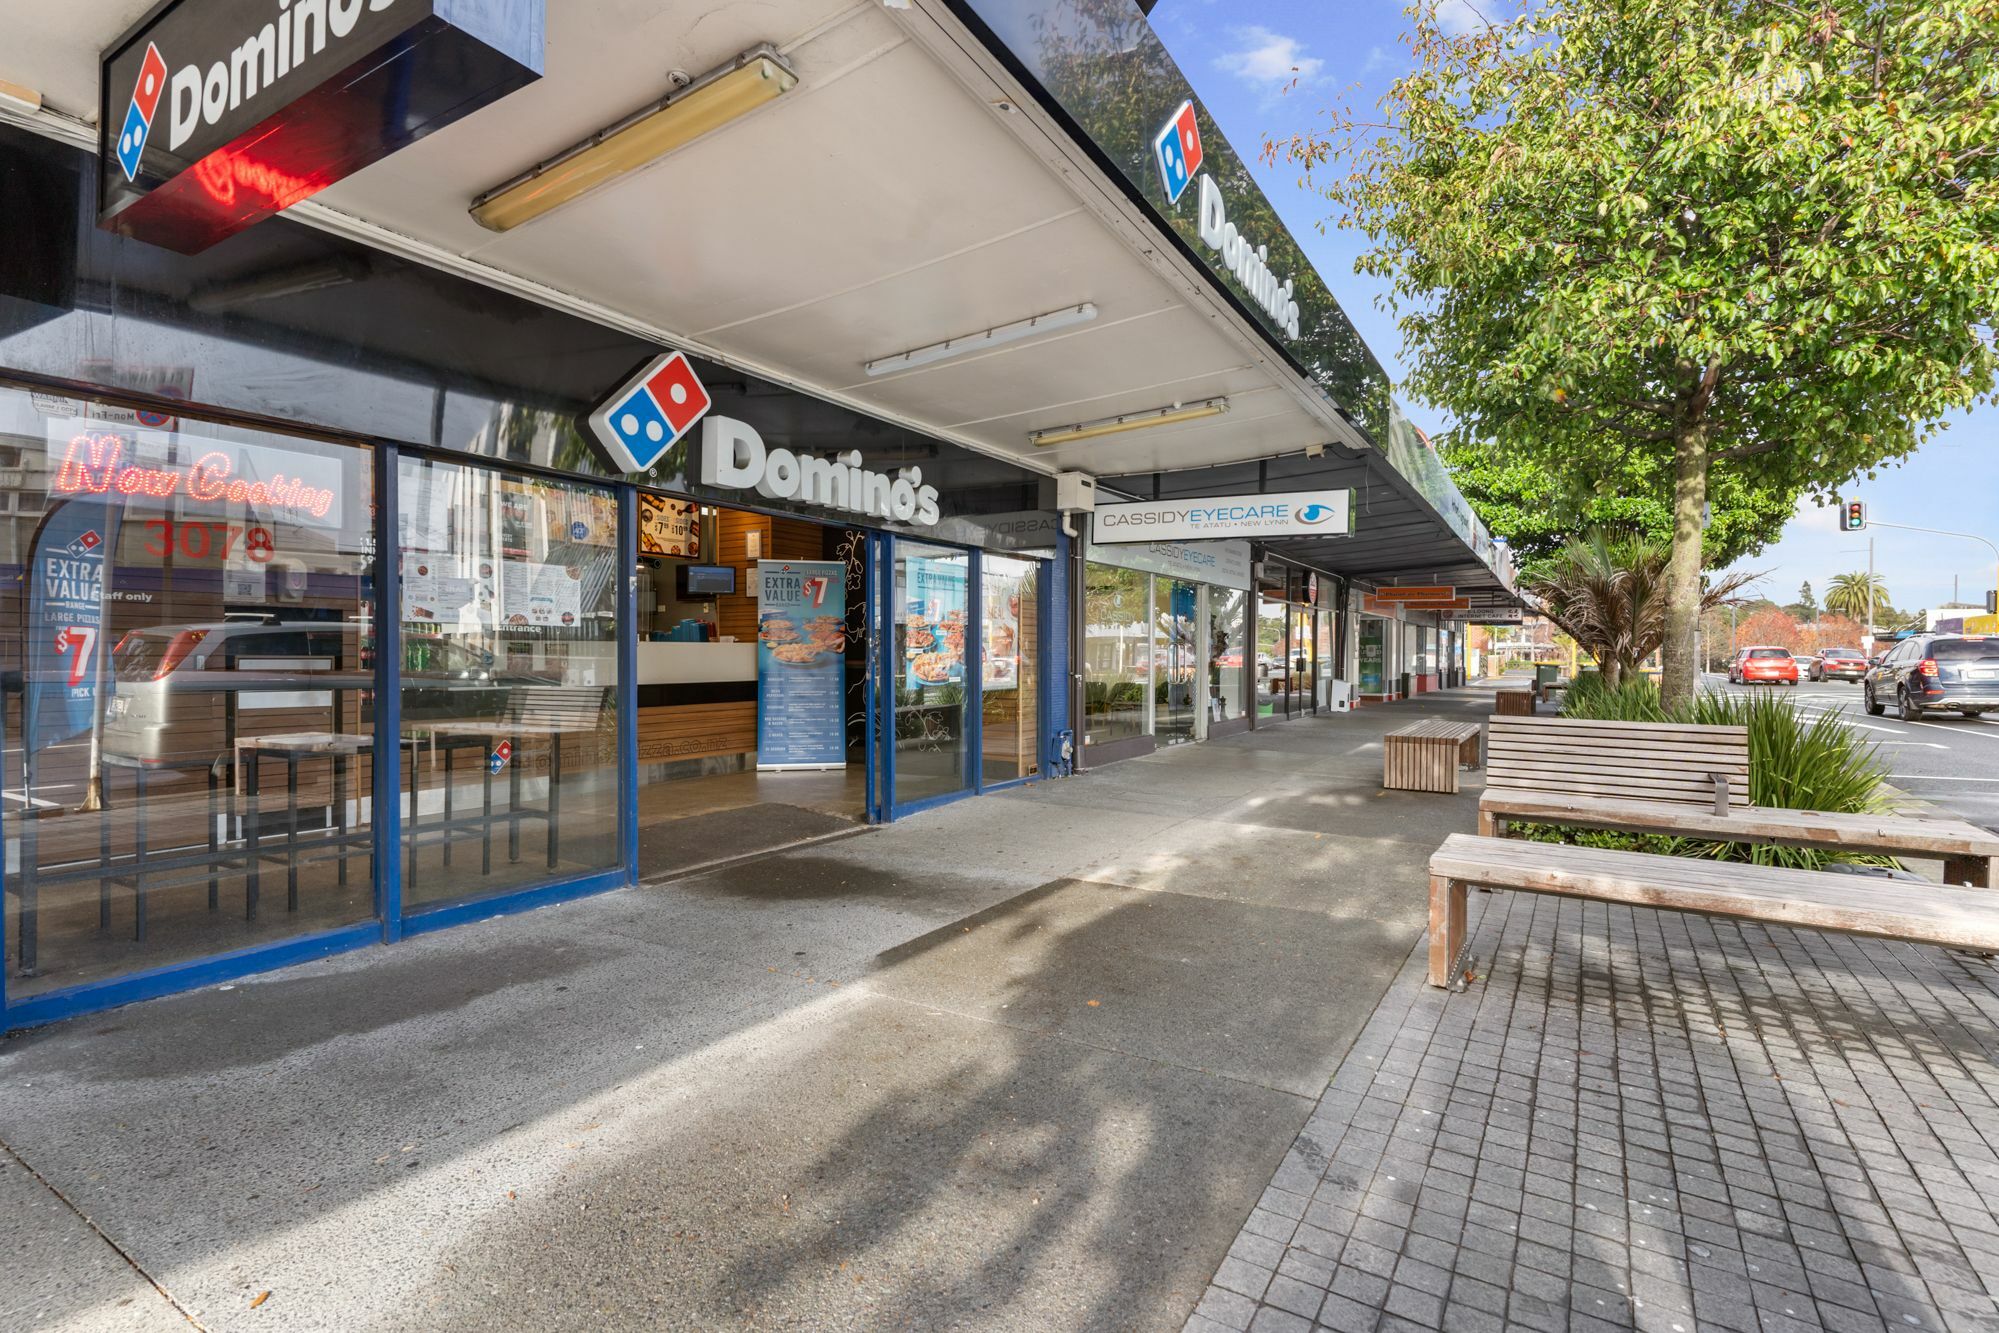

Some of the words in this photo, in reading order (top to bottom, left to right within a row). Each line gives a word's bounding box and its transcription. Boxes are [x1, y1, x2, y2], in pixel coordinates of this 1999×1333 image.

[170, 0, 397, 152] Domino
[1198, 173, 1300, 341] Domino's
[56, 434, 180, 496] Now
[187, 451, 335, 518] Cooking
[701, 414, 940, 526] Domino's
[1203, 521, 1232, 529] ATATU
[1240, 520, 1262, 528] NEW
[143, 518, 275, 563] 3078
[46, 558, 103, 582] EXTRA
[765, 576, 801, 589] EXTRA
[46, 578, 102, 603] VALUE
[126, 592, 153, 603] only
[765, 589, 801, 602] VALUE
[803, 577, 828, 605] $7
[45, 612, 74, 622] LARGE
[57, 626, 96, 678] $7
[71, 687, 90, 697] PICK
